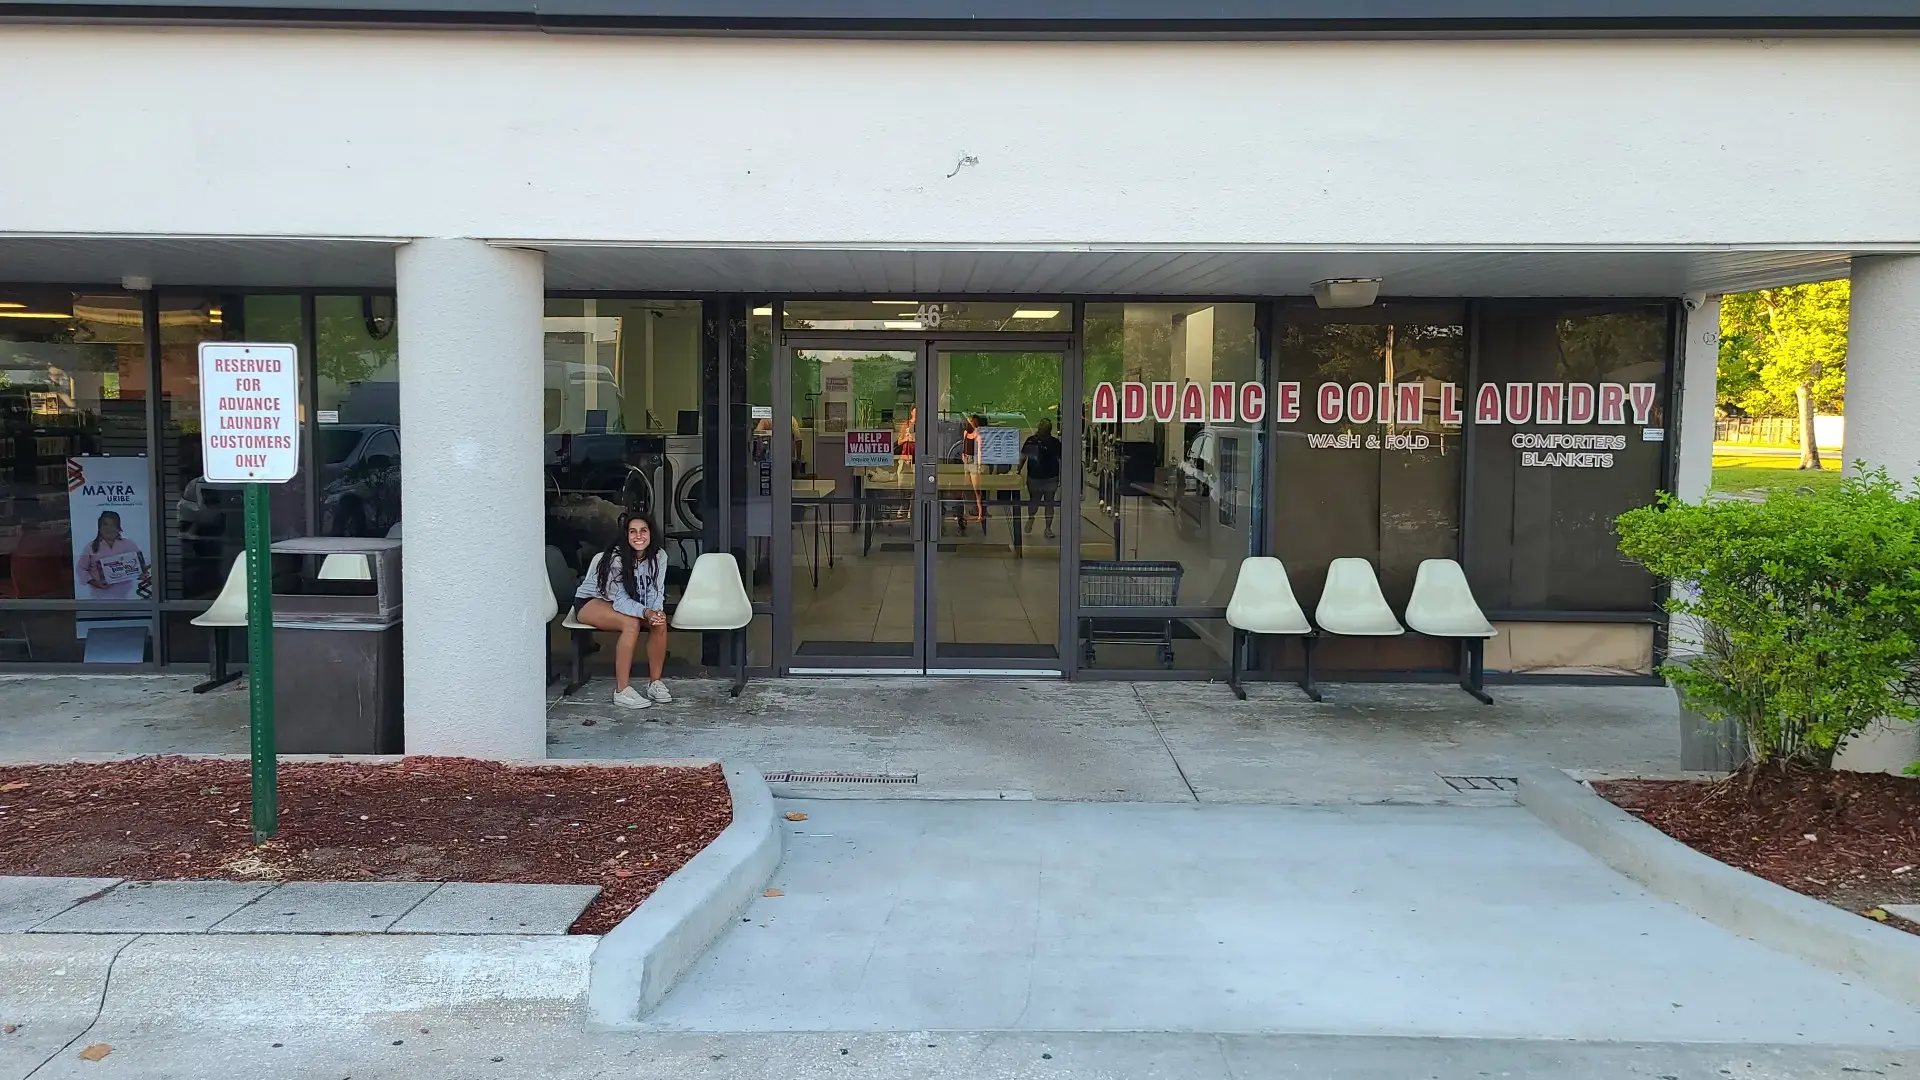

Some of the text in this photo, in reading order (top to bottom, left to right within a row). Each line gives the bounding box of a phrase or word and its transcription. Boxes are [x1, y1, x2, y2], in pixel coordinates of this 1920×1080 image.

[913, 304, 941, 328] 46
[215, 359, 281, 373] RESERVED
[236, 378, 261, 392] FOR
[219, 397, 281, 411] ADVANCE
[1317, 381, 1424, 424] COIN
[220, 416, 281, 430] LAUNDRY
[210, 435, 291, 449] CUSTOMERS
[858, 432, 882, 442] HELP
[1307, 434, 1430, 450] WASH & FOLD
[1511, 434, 1626, 450] COMFORTERS
[850, 443, 889, 452] WANTED
[235, 454, 267, 468] ONLY
[1521, 451, 1614, 468] BLANKETS
[82, 486, 134, 496] MAYRA
